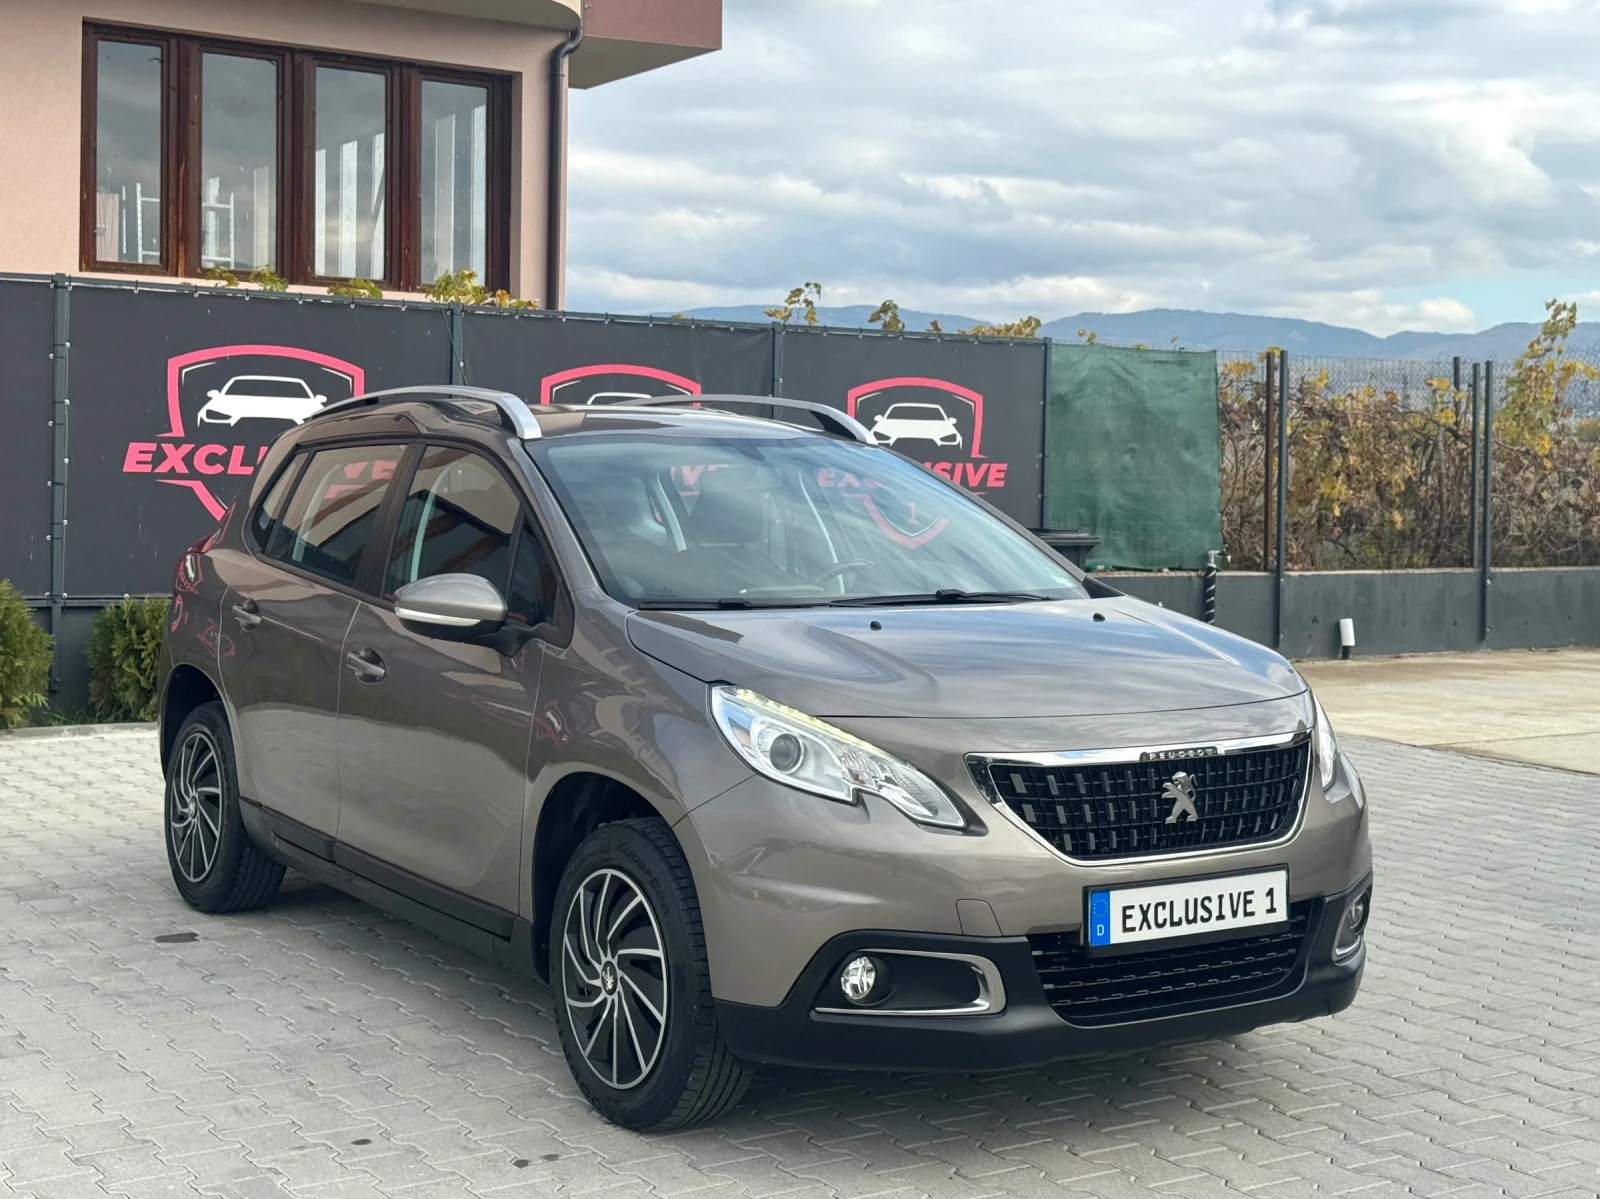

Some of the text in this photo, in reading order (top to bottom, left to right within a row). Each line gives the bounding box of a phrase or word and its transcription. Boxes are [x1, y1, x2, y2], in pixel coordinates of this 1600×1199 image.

[1149, 748, 1214, 761] PEUGEOT
[1121, 887, 1277, 933] EXCLUSIVE 1
[1096, 924, 1105, 936] D
